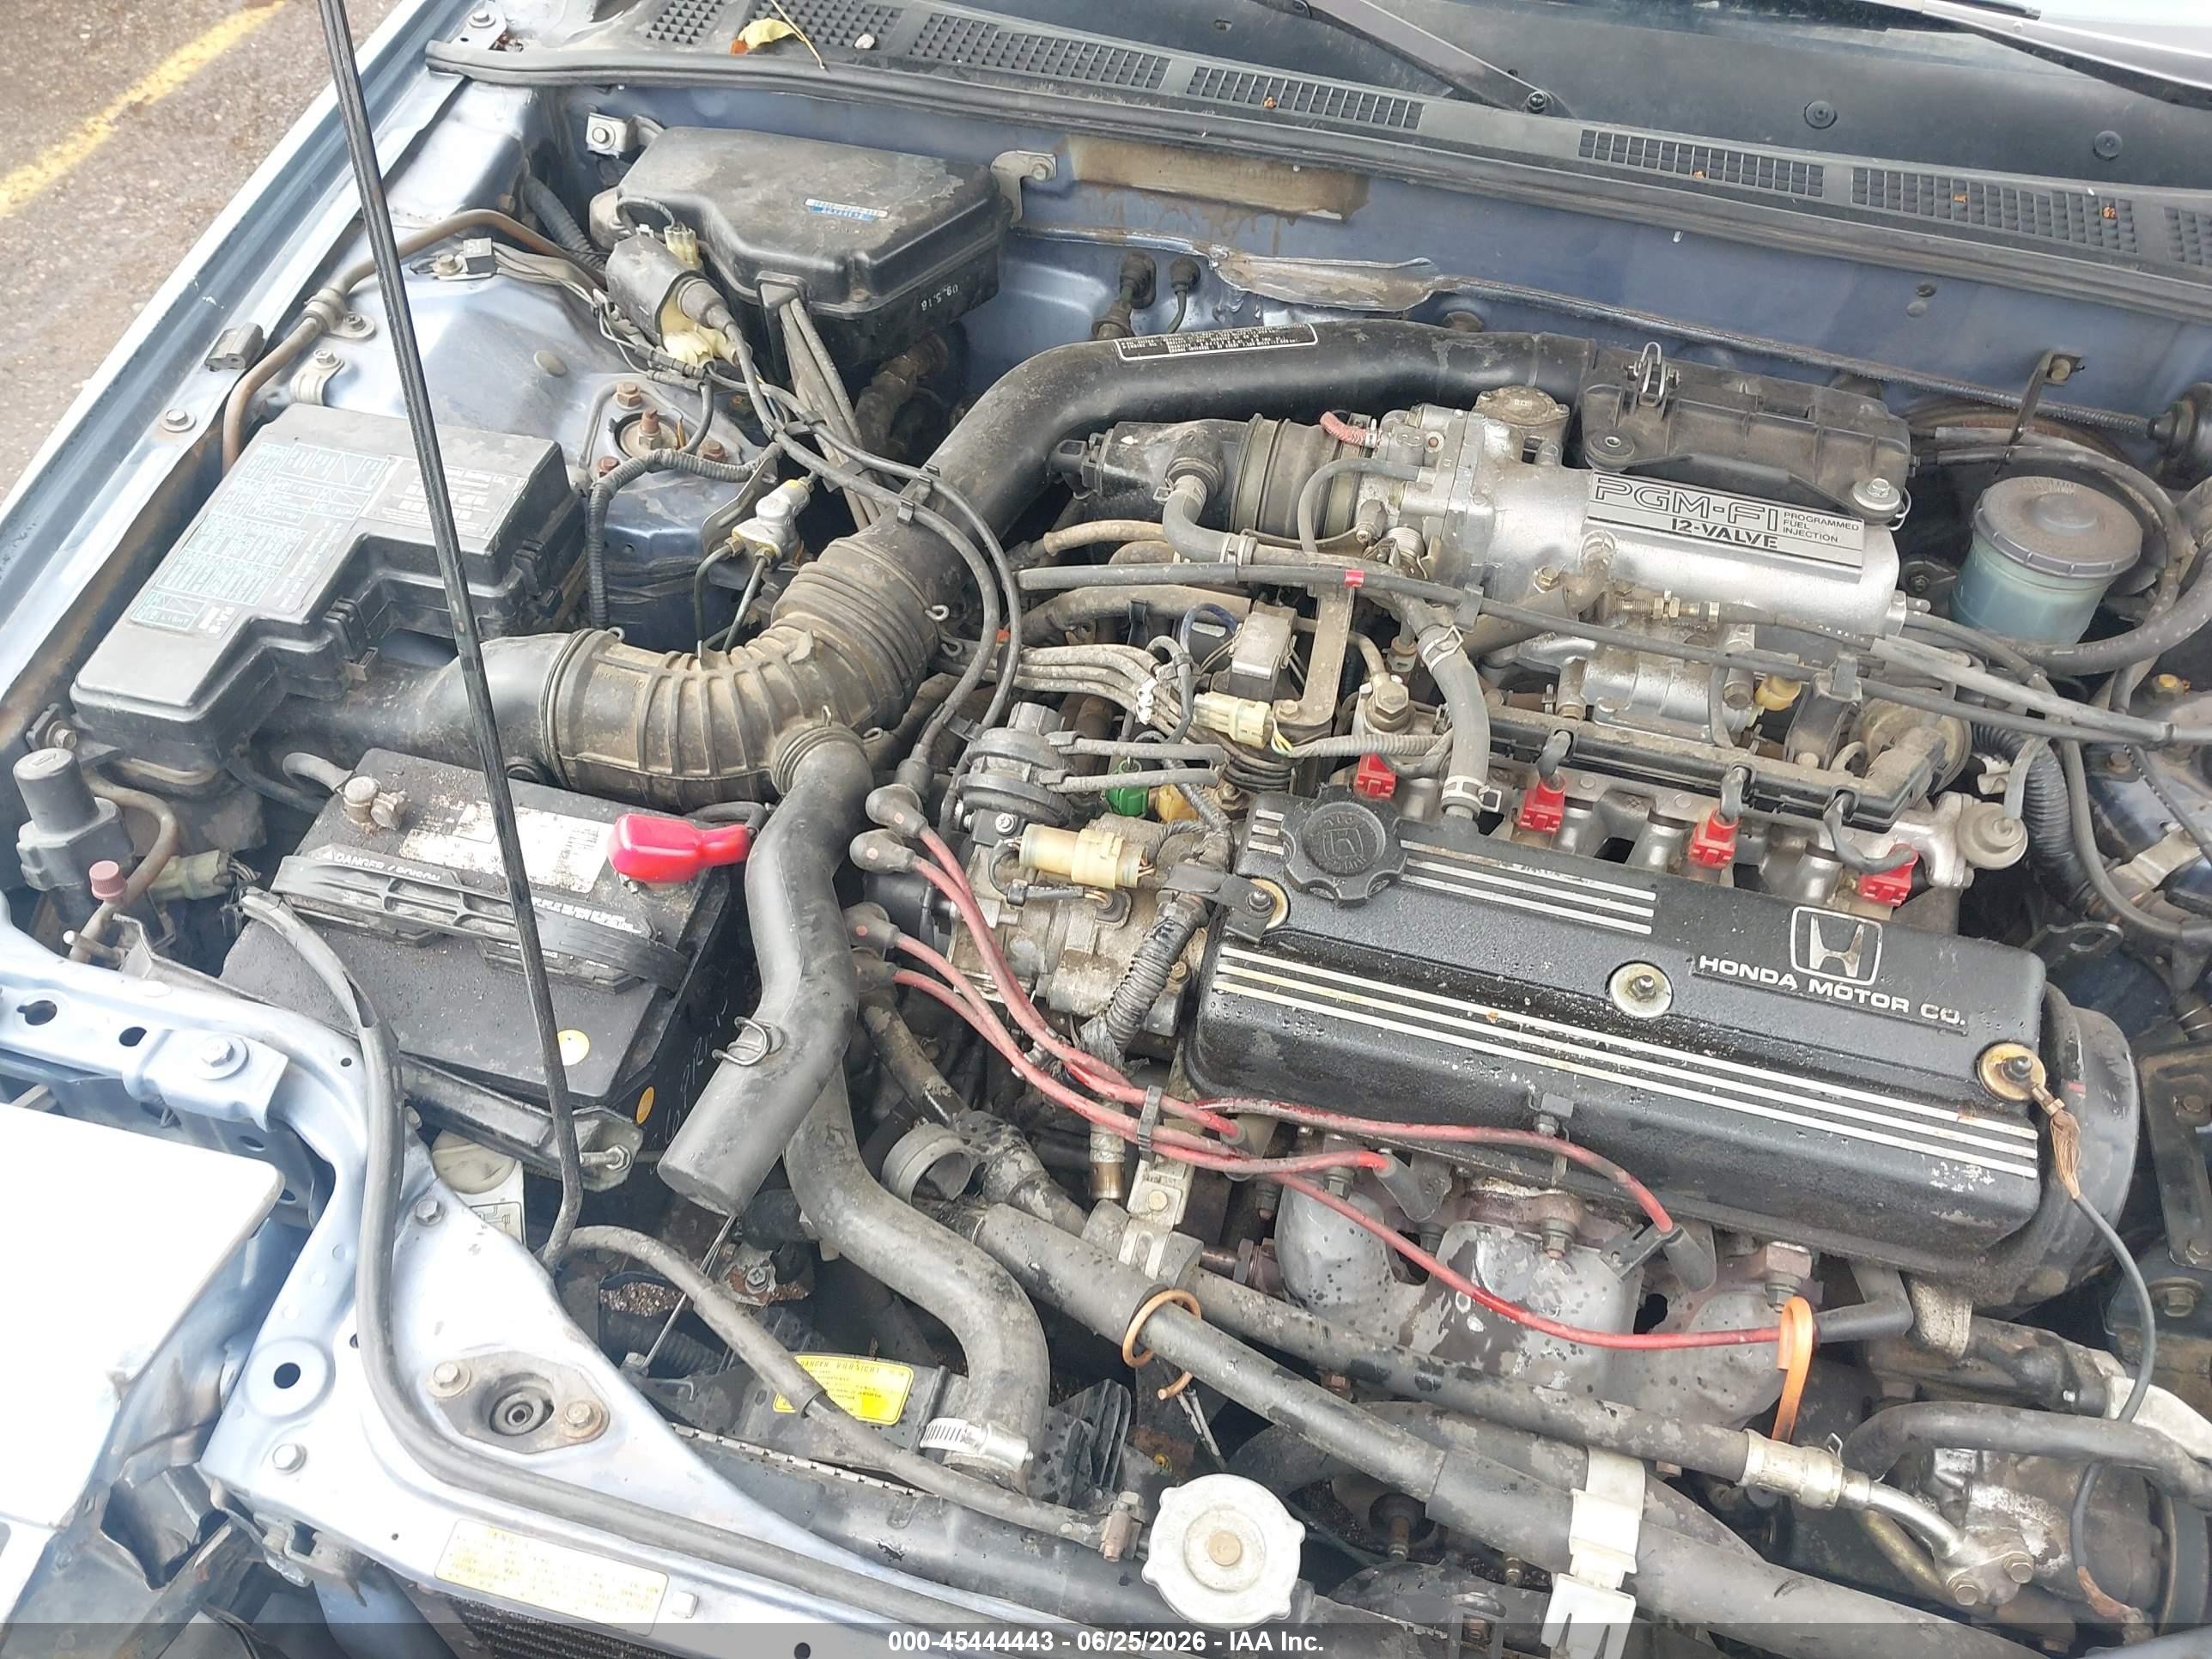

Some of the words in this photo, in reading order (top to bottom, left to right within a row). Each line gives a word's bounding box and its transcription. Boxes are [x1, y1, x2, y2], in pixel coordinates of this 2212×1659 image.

[1595, 477, 1778, 532] PGM-FI
[1671, 517, 1778, 550] 12-VALVE
[1783, 526, 1839, 543] INJECTION
[1784, 511, 1860, 532] PROGRAMMED
[1784, 520, 1811, 531] FUEL
[1698, 954, 1798, 990] HONDA
[1808, 977, 1910, 1013] MOTOR
[1920, 1002, 1966, 1026] CO.
